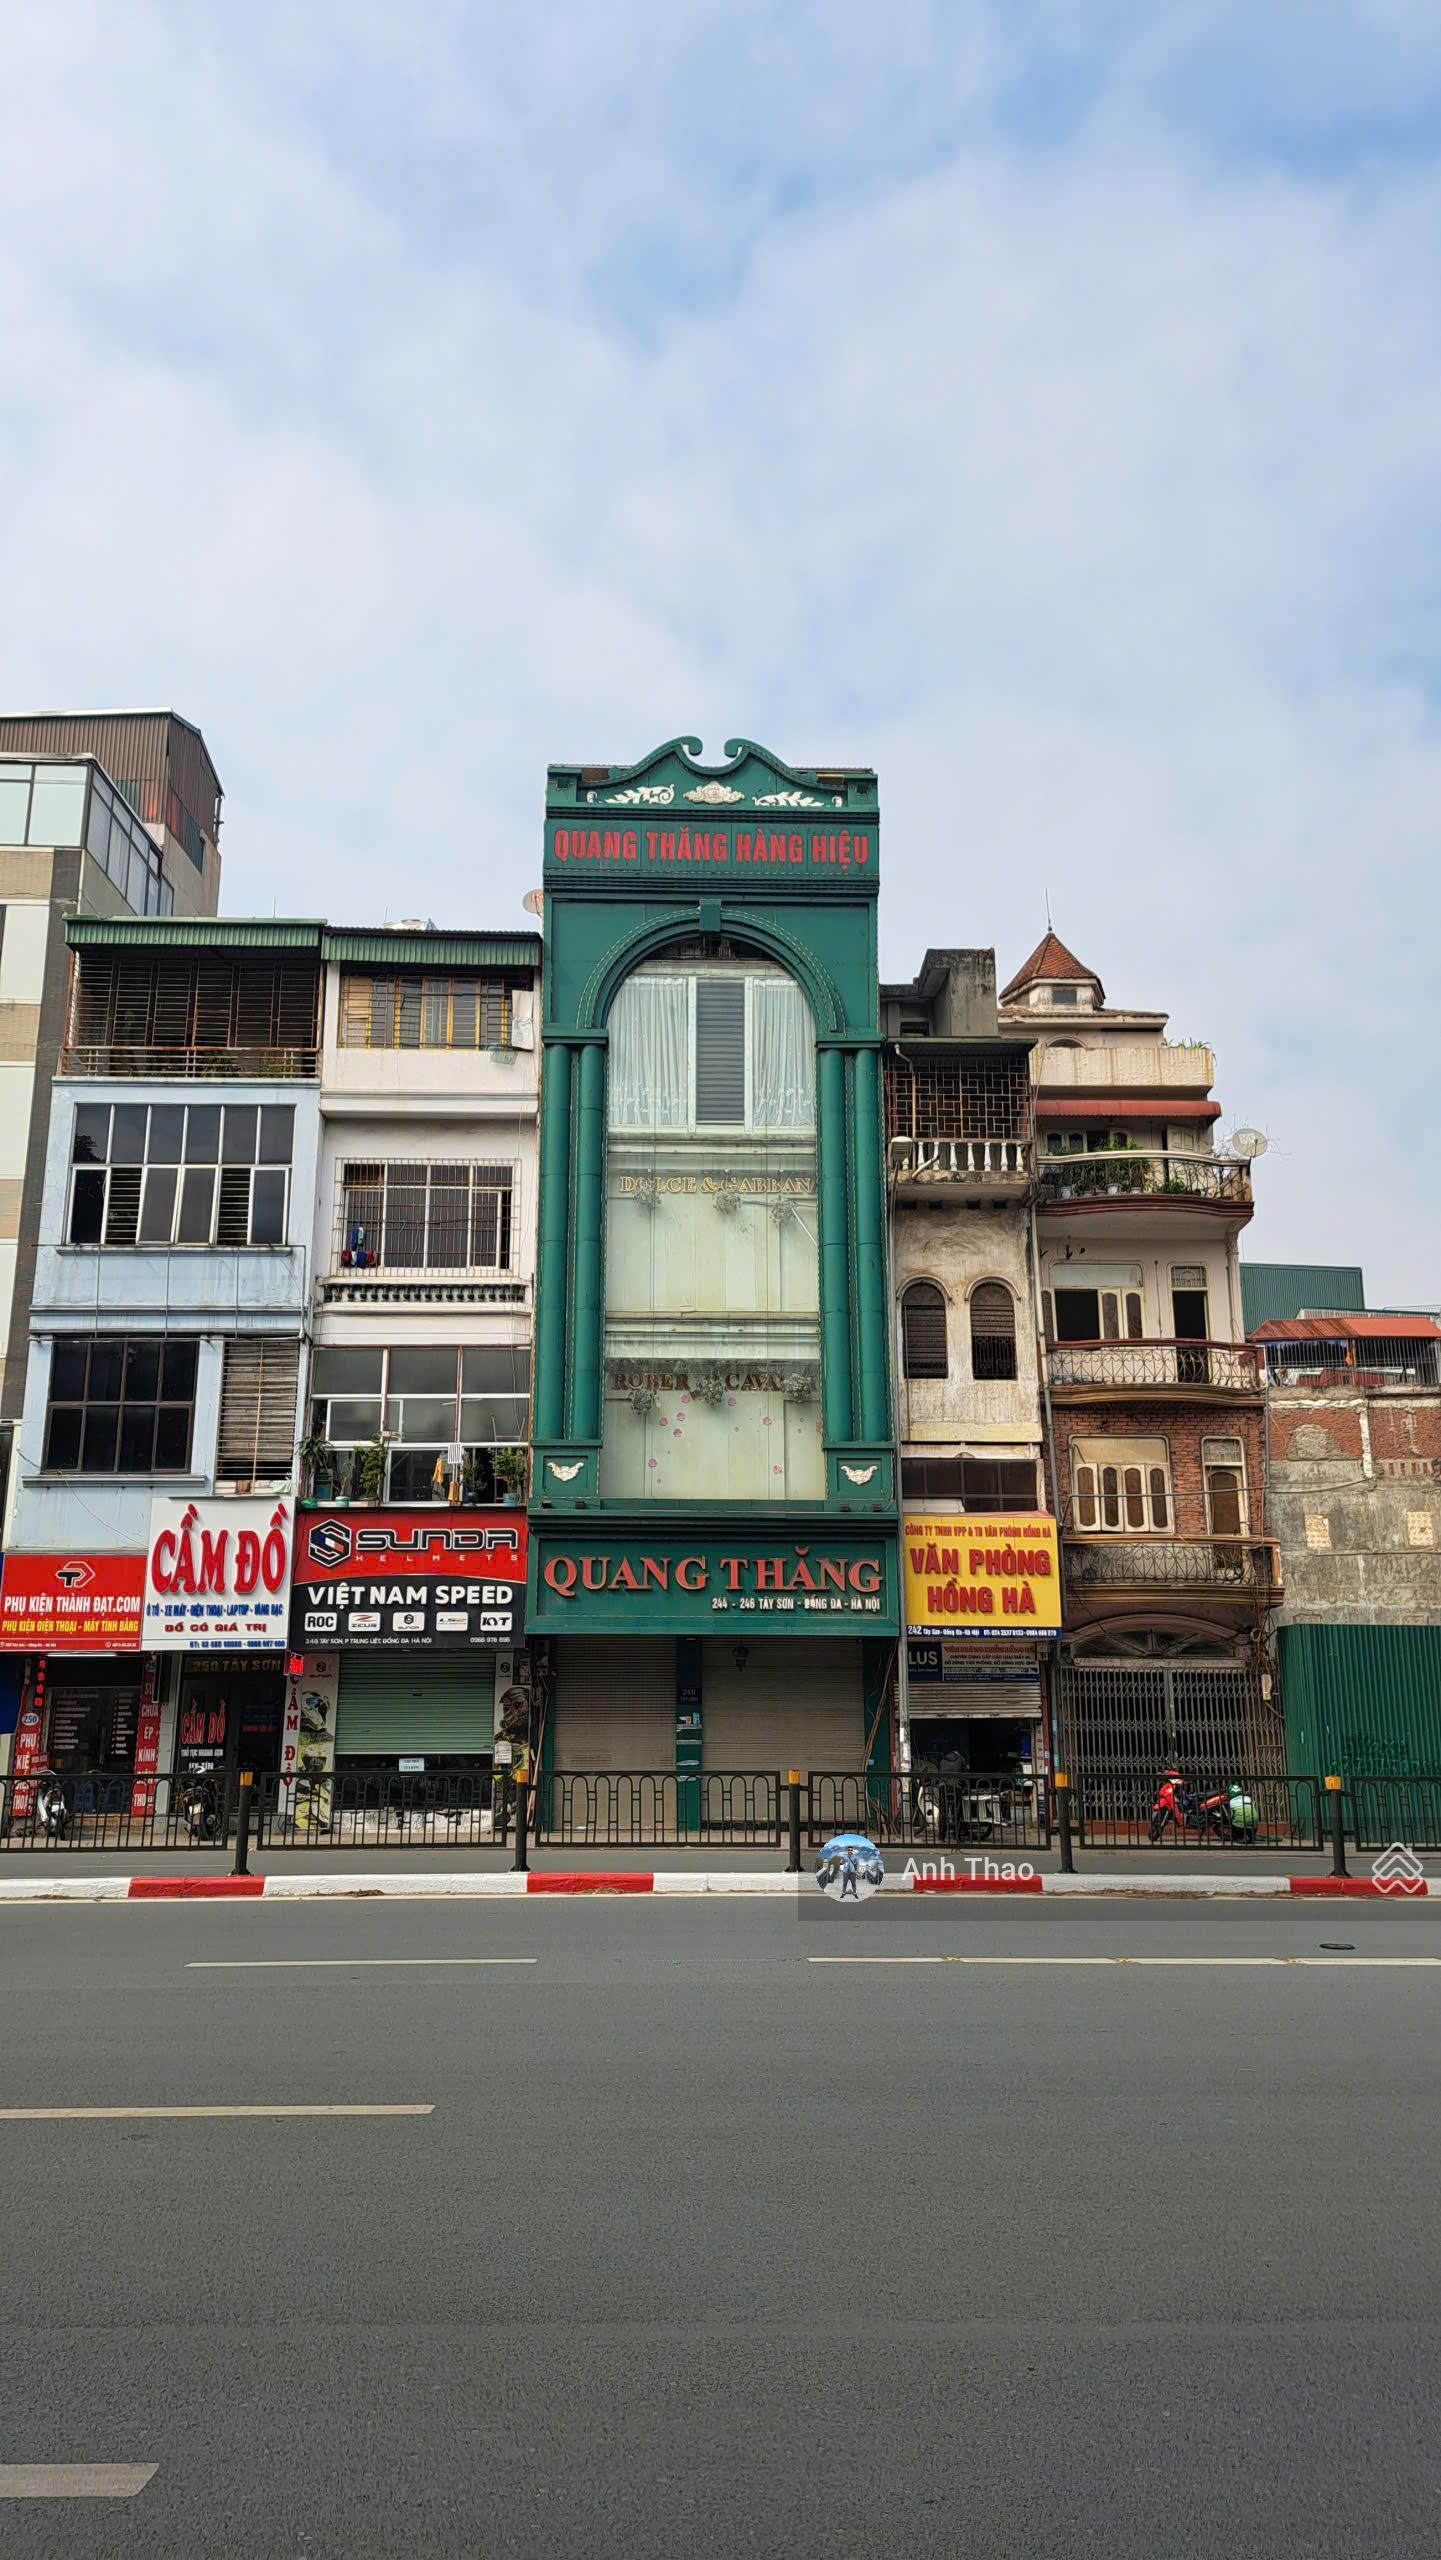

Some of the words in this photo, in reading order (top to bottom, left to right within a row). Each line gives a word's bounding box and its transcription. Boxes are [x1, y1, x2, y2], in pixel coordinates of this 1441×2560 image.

[553, 830, 637, 862] QUANG
[735, 828, 803, 864] HÀNG
[811, 830, 868, 870] HIỆU
[356, 1528, 519, 1550] SUNDA
[924, 1525, 932, 1536] TY
[151, 1503, 229, 1594] CẦM
[234, 1502, 288, 1594] ĐỒ
[909, 1542, 960, 1575] VĂN
[968, 1543, 1052, 1575] PHÒNG
[544, 1556, 710, 1596] QUANG
[4, 1597, 26, 1616] PHỤ
[29, 1593, 53, 1616] KIỆN
[56, 1593, 90, 1612] THÀNH
[93, 1596, 141, 1616] ĐẠT.COM
[307, 1582, 366, 1609] VIỆT
[369, 1586, 428, 1605] NAM
[435, 1586, 514, 1605] SPEED
[712, 1598, 728, 1609] 244
[740, 1598, 755, 1609] 246
[759, 1596, 773, 1609] TÂY
[927, 1577, 994, 1612] HỒNG
[1001, 1581, 1036, 1613] HÀ
[2, 1621, 17, 1634] PHỤ
[56, 1621, 77, 1634] THOẠI
[83, 1619, 100, 1632] MÁY
[215, 1622, 238, 1632] GIÁ
[245, 1623, 267, 1633] TRỊ
[307, 1616, 334, 1628] ROC
[907, 1626, 922, 1635] 242
